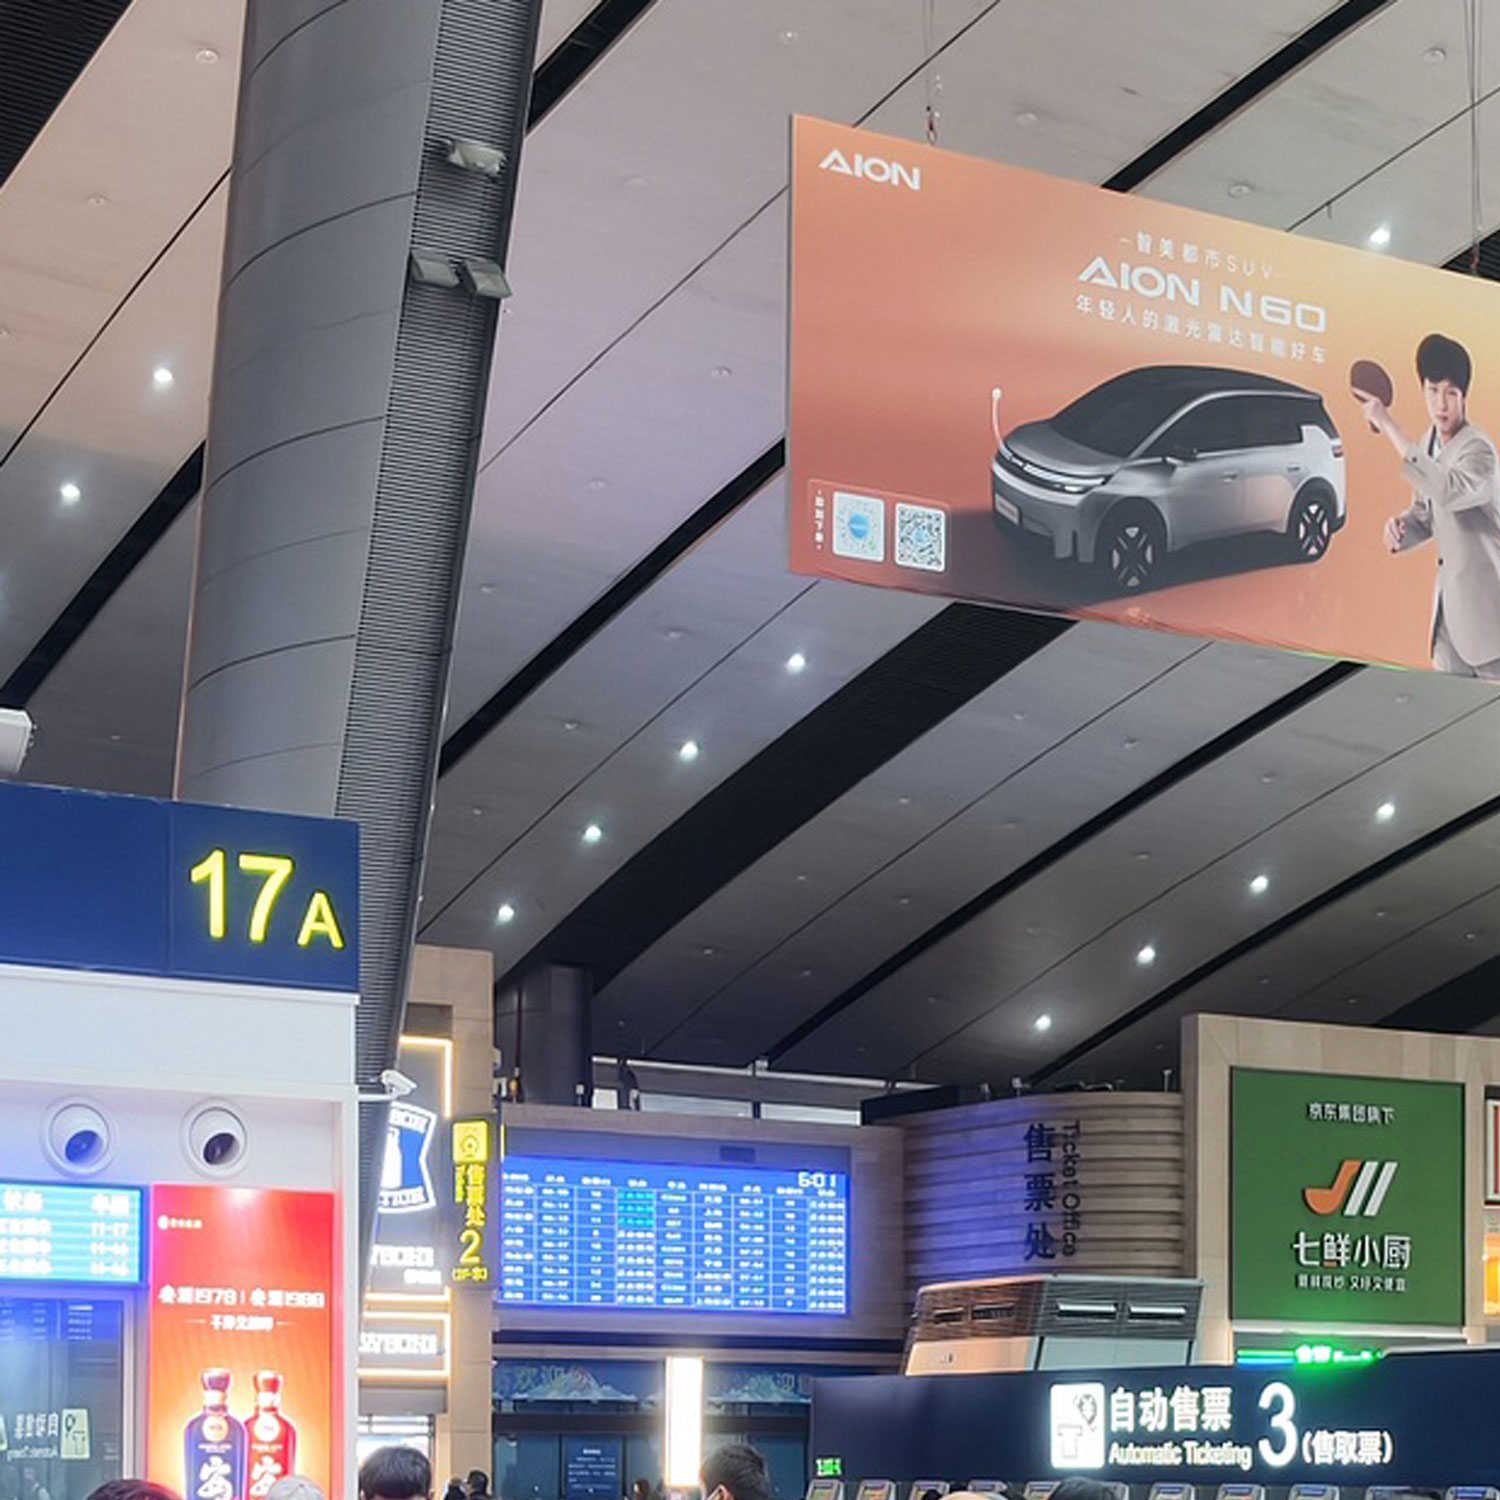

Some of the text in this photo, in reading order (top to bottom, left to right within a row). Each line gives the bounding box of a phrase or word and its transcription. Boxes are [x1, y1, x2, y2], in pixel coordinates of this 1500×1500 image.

[818, 148, 921, 191] AION
[1078, 255, 1327, 334] AION N60
[190, 848, 346, 949] 17A
[1023, 1122, 1056, 1262] 售票处
[1061, 1119, 1081, 1257] Ticket Office
[459, 1228, 482, 1266] 2
[1292, 1230, 1412, 1272] 七鲜小厨
[1109, 1385, 1233, 1432] 自动售票
[1257, 1381, 1298, 1468] 3
[1108, 1440, 1253, 1471] Automatic Ticketing
